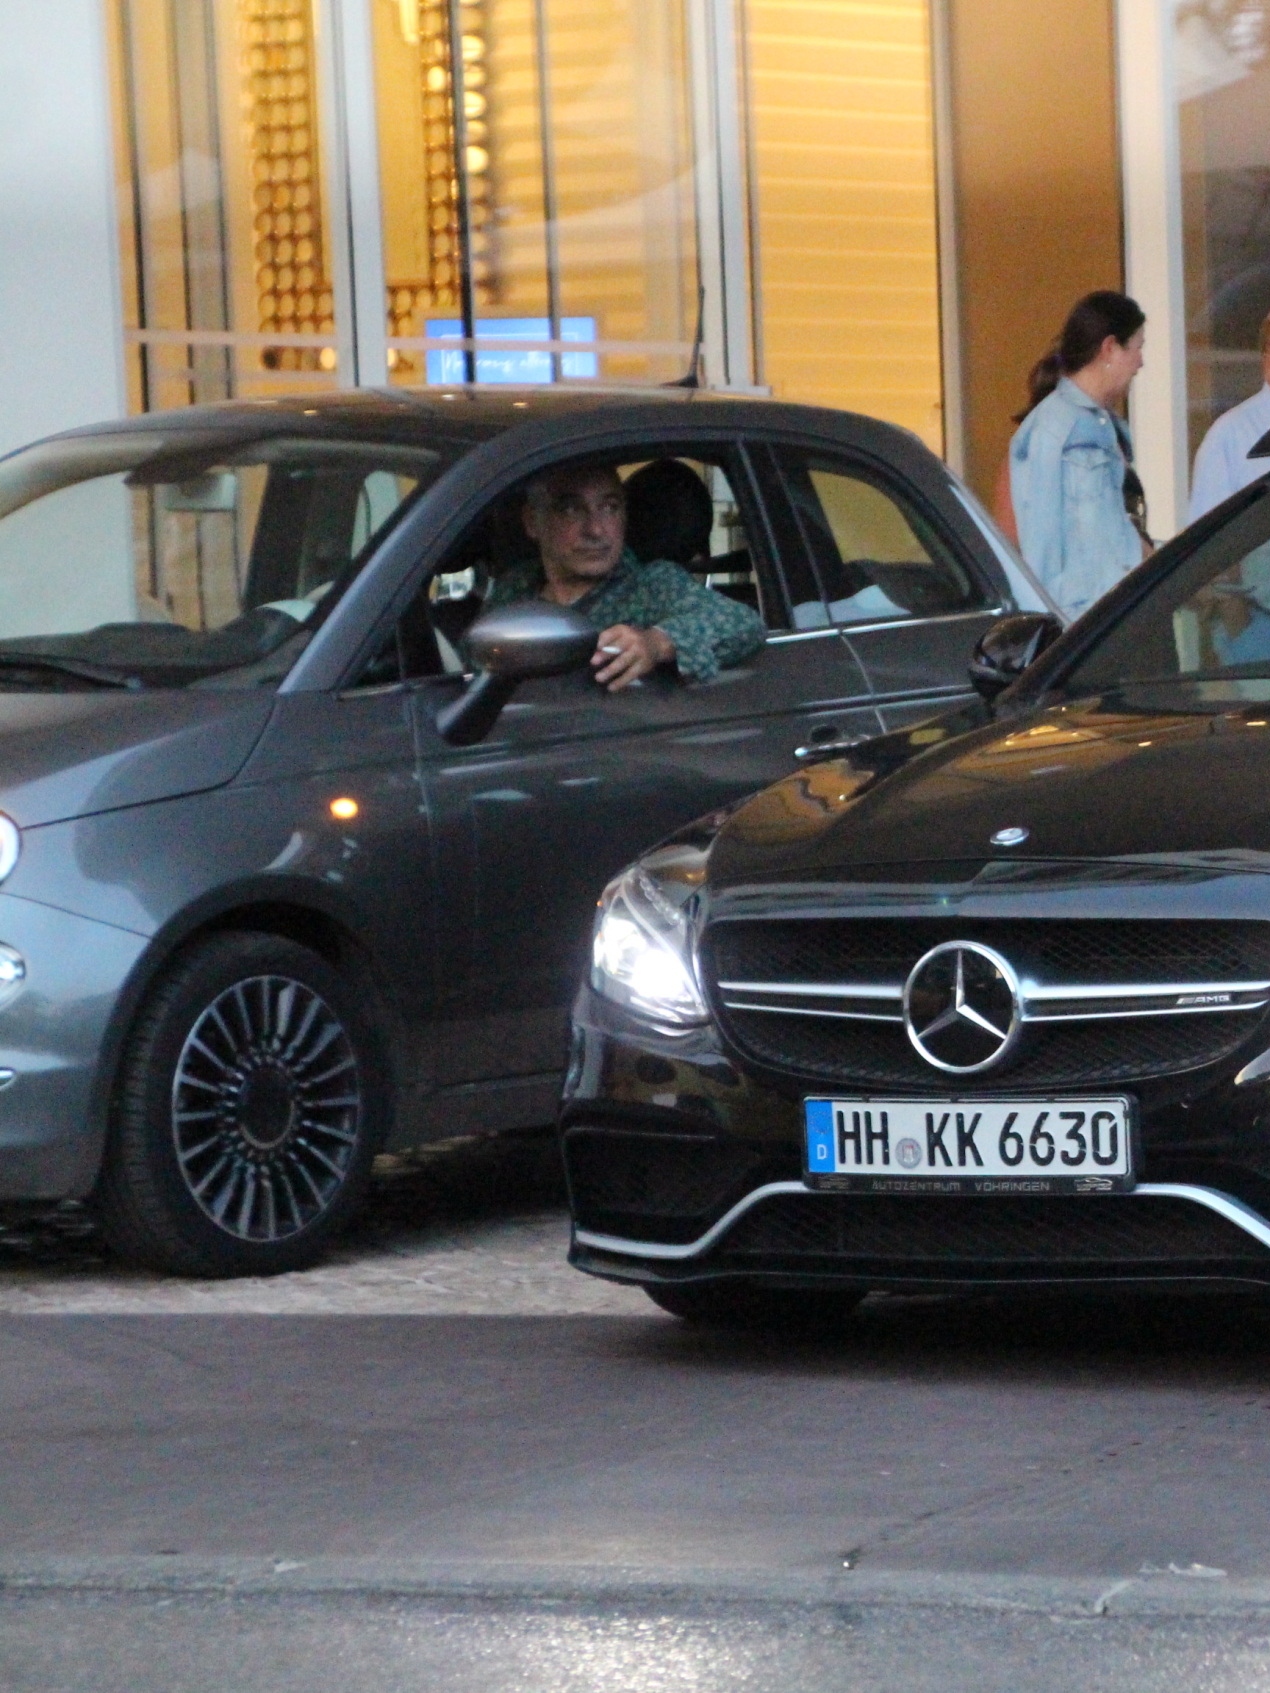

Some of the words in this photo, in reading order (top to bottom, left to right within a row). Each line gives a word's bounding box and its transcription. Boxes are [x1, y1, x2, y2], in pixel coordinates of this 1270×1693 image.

[1194, 995, 1230, 1003] AMG
[836, 1110, 890, 1165] HH
[925, 1112, 985, 1167] KK
[999, 1111, 1119, 1167] 6630
[816, 1144, 828, 1160] D
